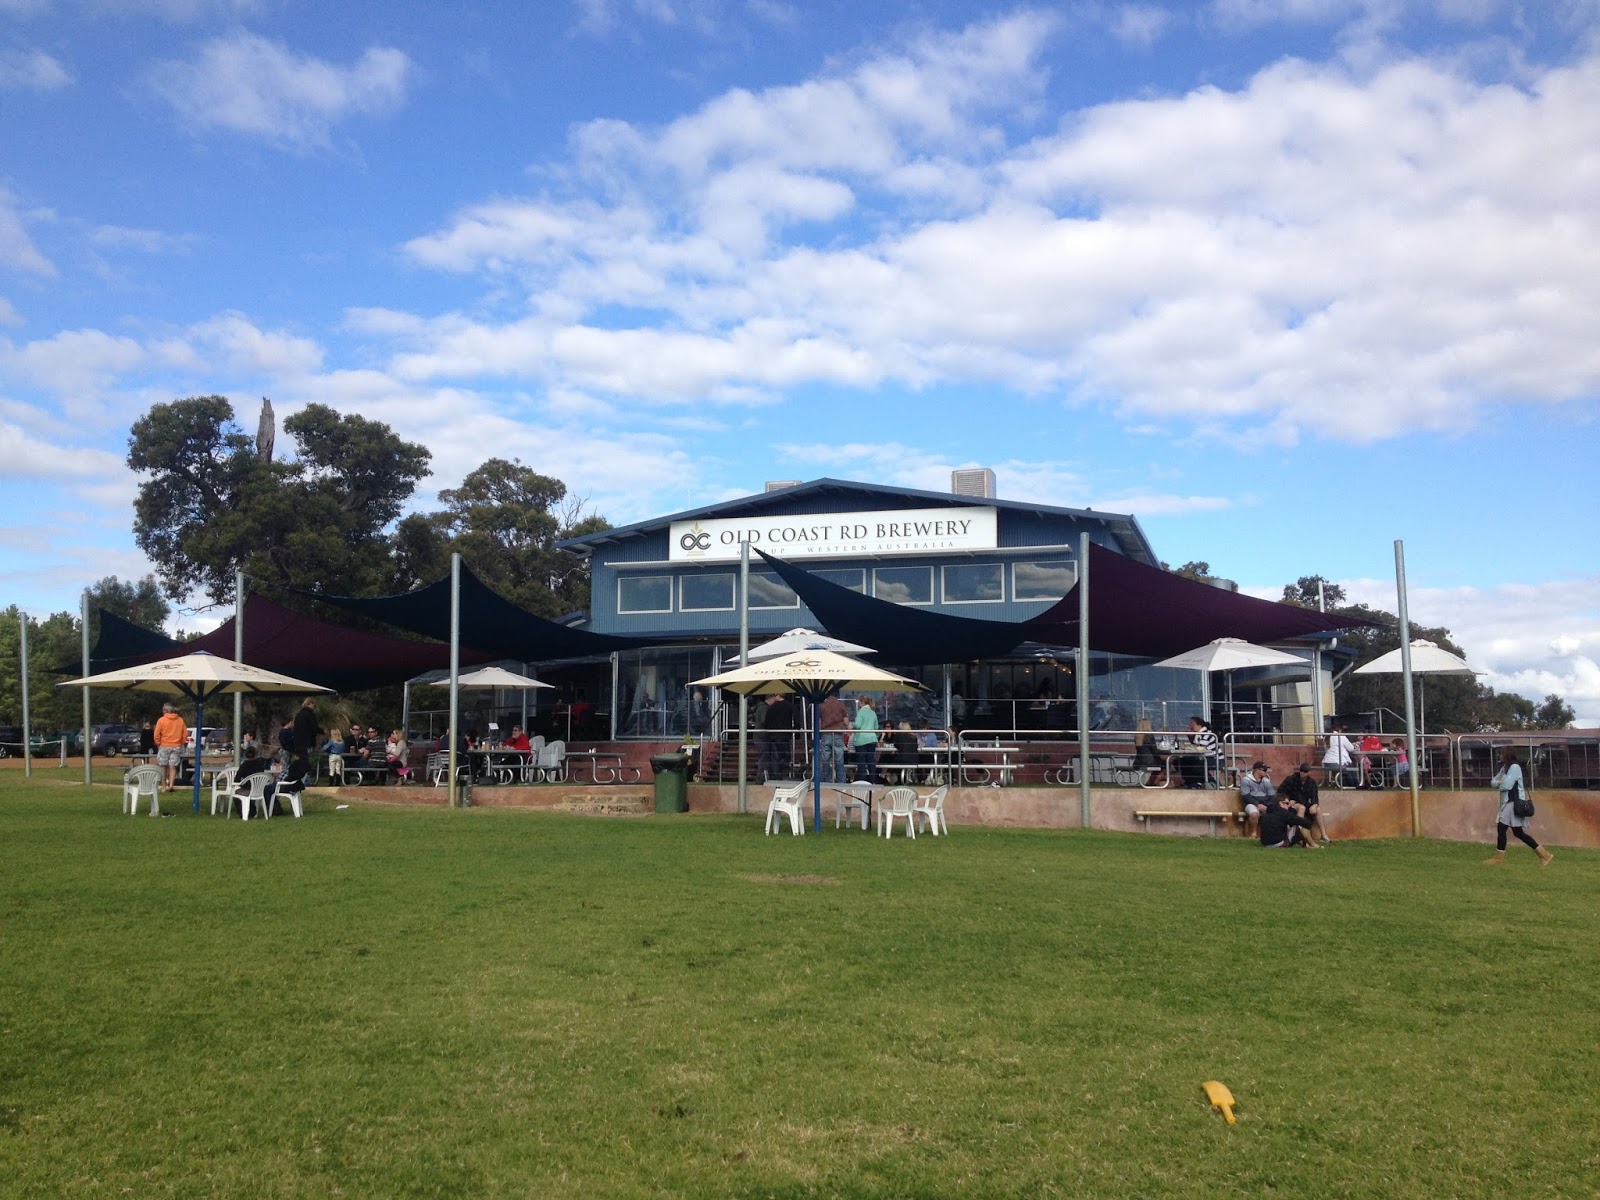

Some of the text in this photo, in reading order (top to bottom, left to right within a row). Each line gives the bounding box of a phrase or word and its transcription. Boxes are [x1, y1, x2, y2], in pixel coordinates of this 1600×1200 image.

[720, 519, 972, 545] OLD COAST RD BREWERY
[807, 545, 867, 553] WESTERN
[877, 541, 954, 550] AUSTRALIA
